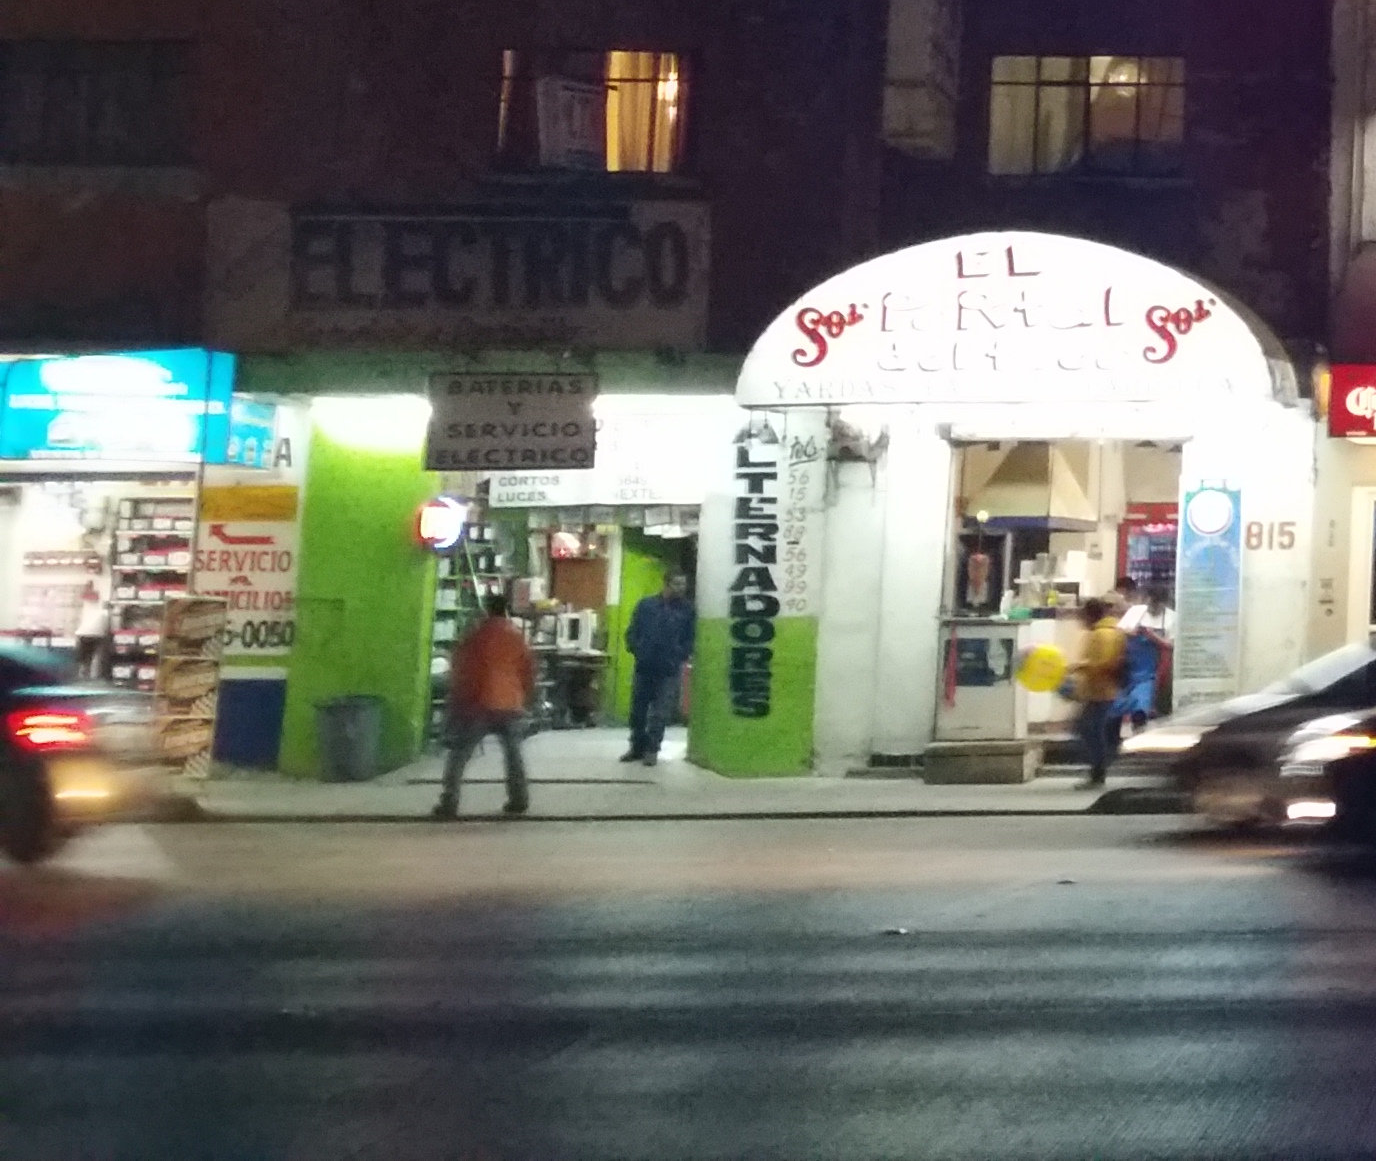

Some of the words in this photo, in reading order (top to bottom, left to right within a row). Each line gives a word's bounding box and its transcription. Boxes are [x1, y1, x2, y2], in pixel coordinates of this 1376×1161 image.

[292, 220, 690, 311] ELECTRICO
[955, 244, 1042, 280] EL
[447, 378, 584, 395] BATERIAS
[507, 401, 524, 416] Y
[446, 421, 581, 439] SERVICIO
[435, 447, 589, 465] ELECTRICO
[498, 475, 561, 487] CORTOS
[497, 491, 547, 502] LUCES
[1245, 521, 1297, 550] 815
[193, 549, 292, 573] SERVICIO
[729, 418, 781, 718] ALTERNADORES
[202, 590, 293, 611] ICILIOS
